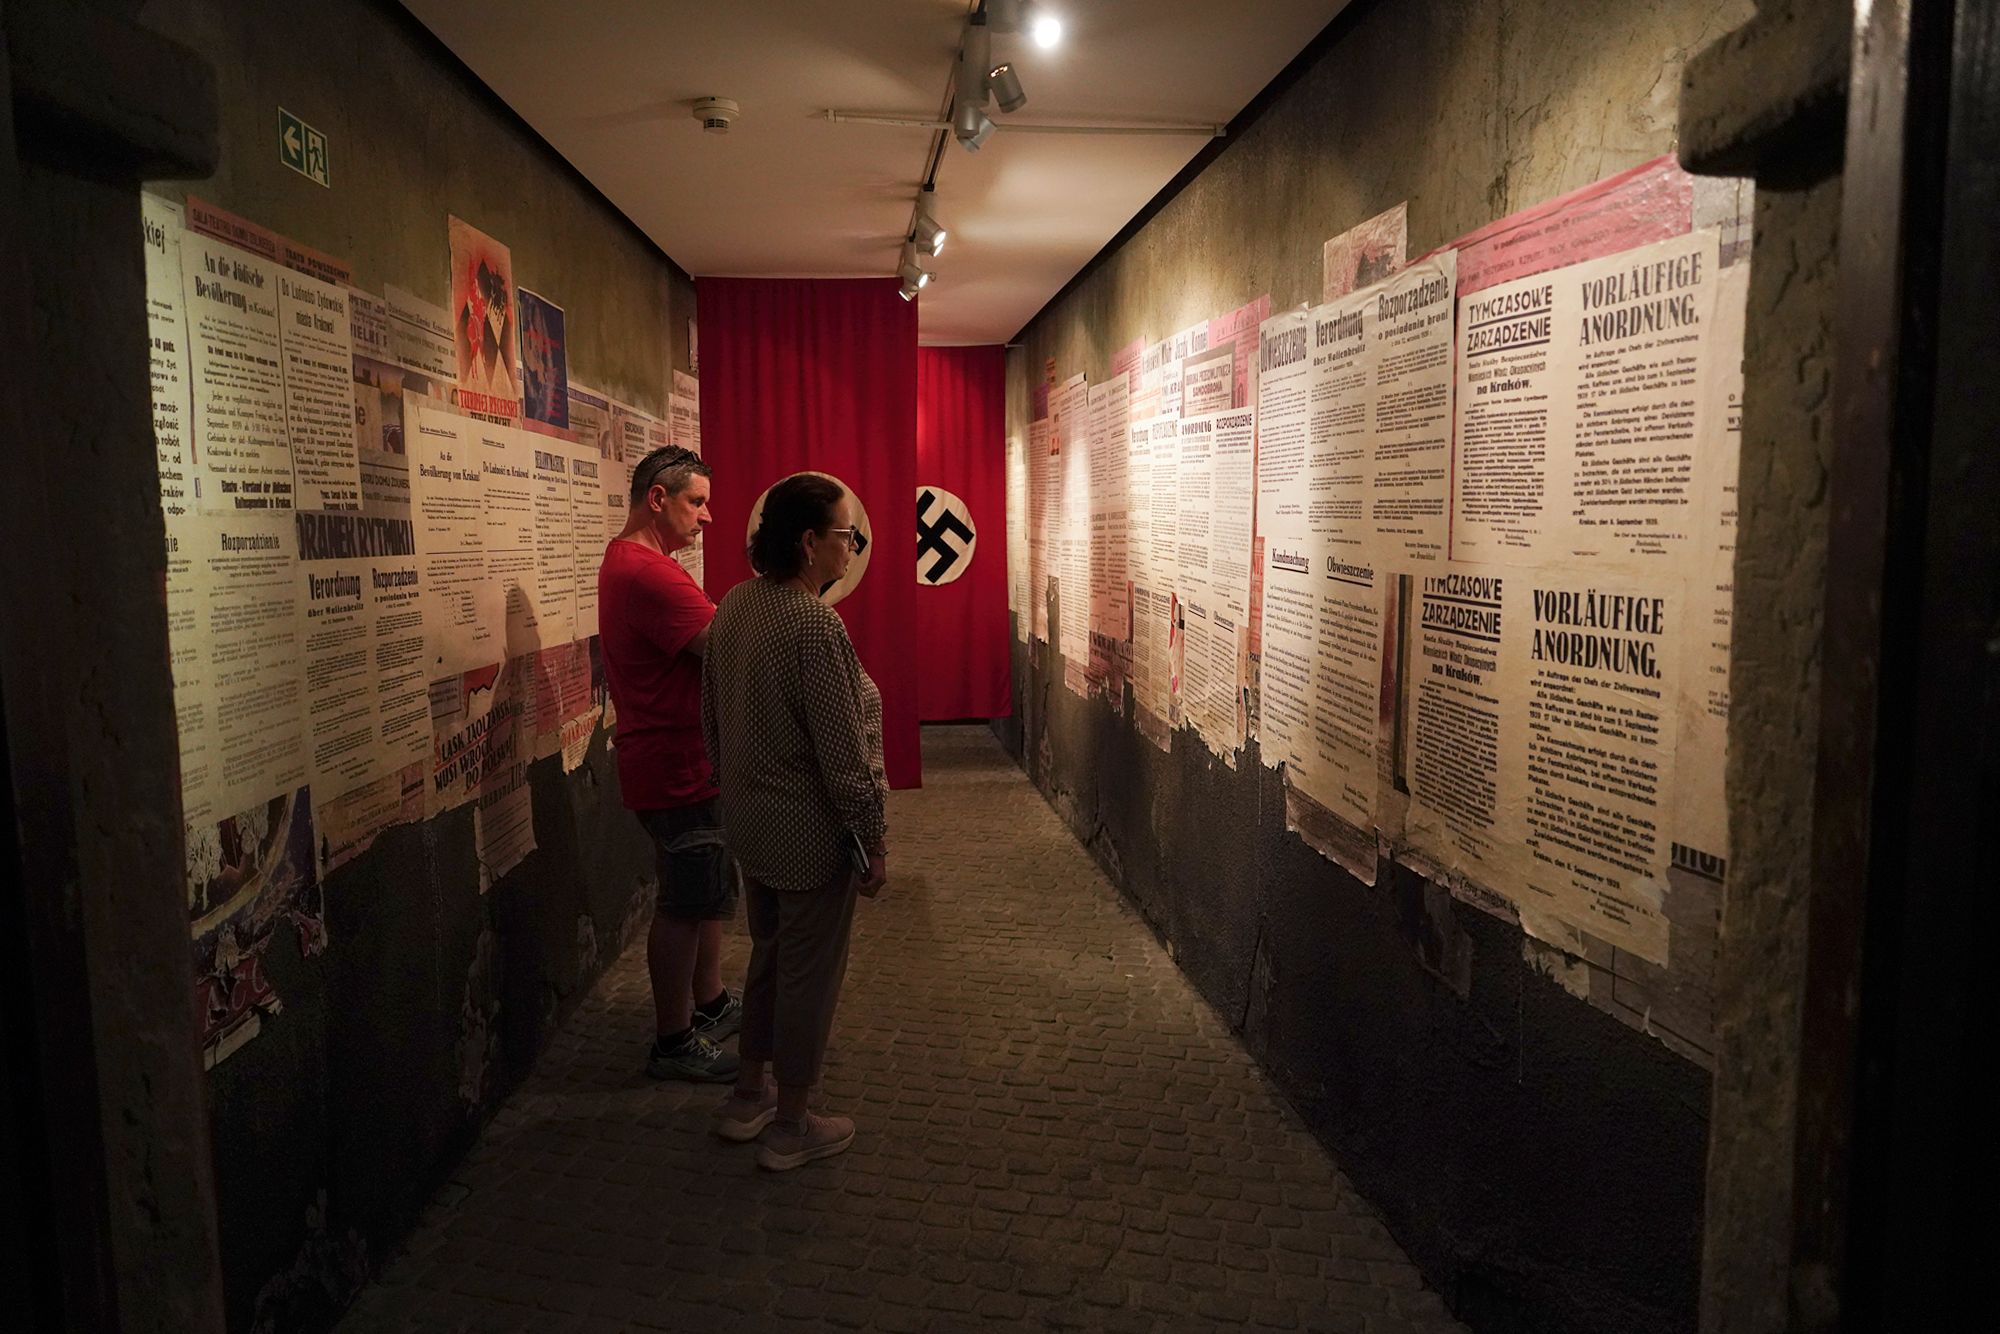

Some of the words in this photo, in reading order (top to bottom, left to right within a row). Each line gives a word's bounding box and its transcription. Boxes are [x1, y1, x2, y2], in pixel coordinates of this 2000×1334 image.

[1378, 273, 1450, 323] Rozporządzenie
[1581, 251, 1703, 311] VORLÄUFIGE
[1469, 285, 1553, 324] TYMCZASOWE
[1579, 293, 1699, 347] ANORDNUNG.
[1315, 310, 1364, 348] Verordnung
[1467, 316, 1551, 352] ZARZĄDZENIE
[1490, 378, 1532, 393] Kraków.
[308, 570, 361, 600] Verordnung
[1422, 602, 1501, 635] ZARZĄDZENIE
[1533, 588, 1664, 635] VORLÄUFIGE
[1531, 628, 1662, 679] ANORDNUNG.
[1432, 663, 1443, 675] na
[1446, 664, 1482, 686] Kraków.
